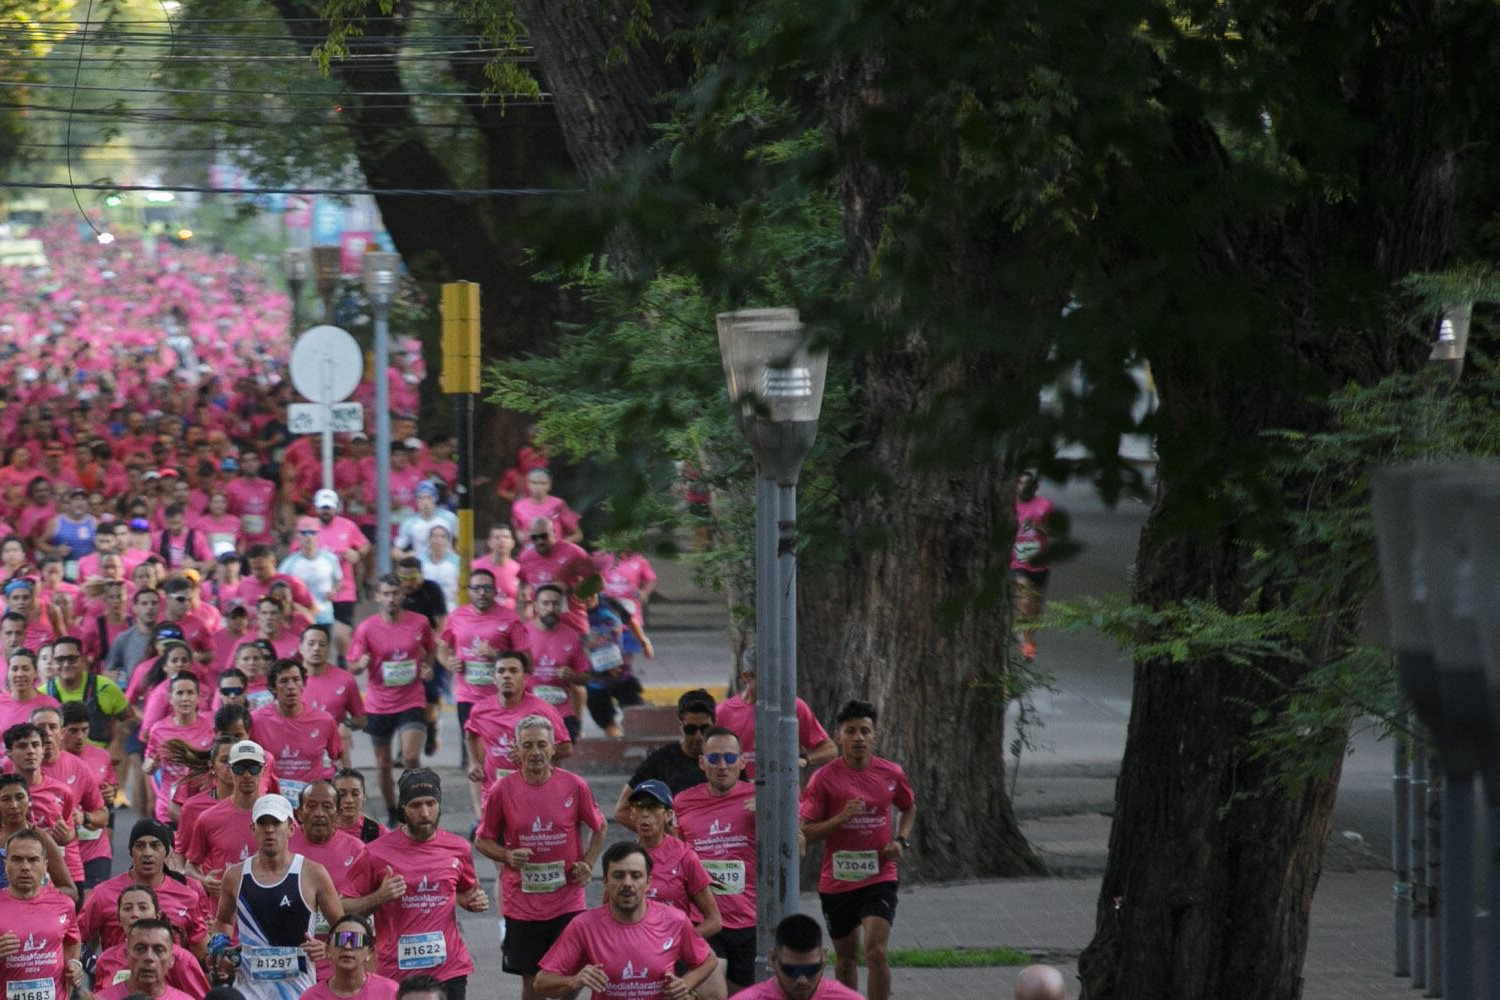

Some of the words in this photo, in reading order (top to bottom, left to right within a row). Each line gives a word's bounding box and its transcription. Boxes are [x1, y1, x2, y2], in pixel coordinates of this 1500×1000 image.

[836, 861, 876, 870] Y3046
[525, 872, 560, 883] Y2335
[403, 943, 441, 955] #1622
[256, 957, 292, 968] #1297
